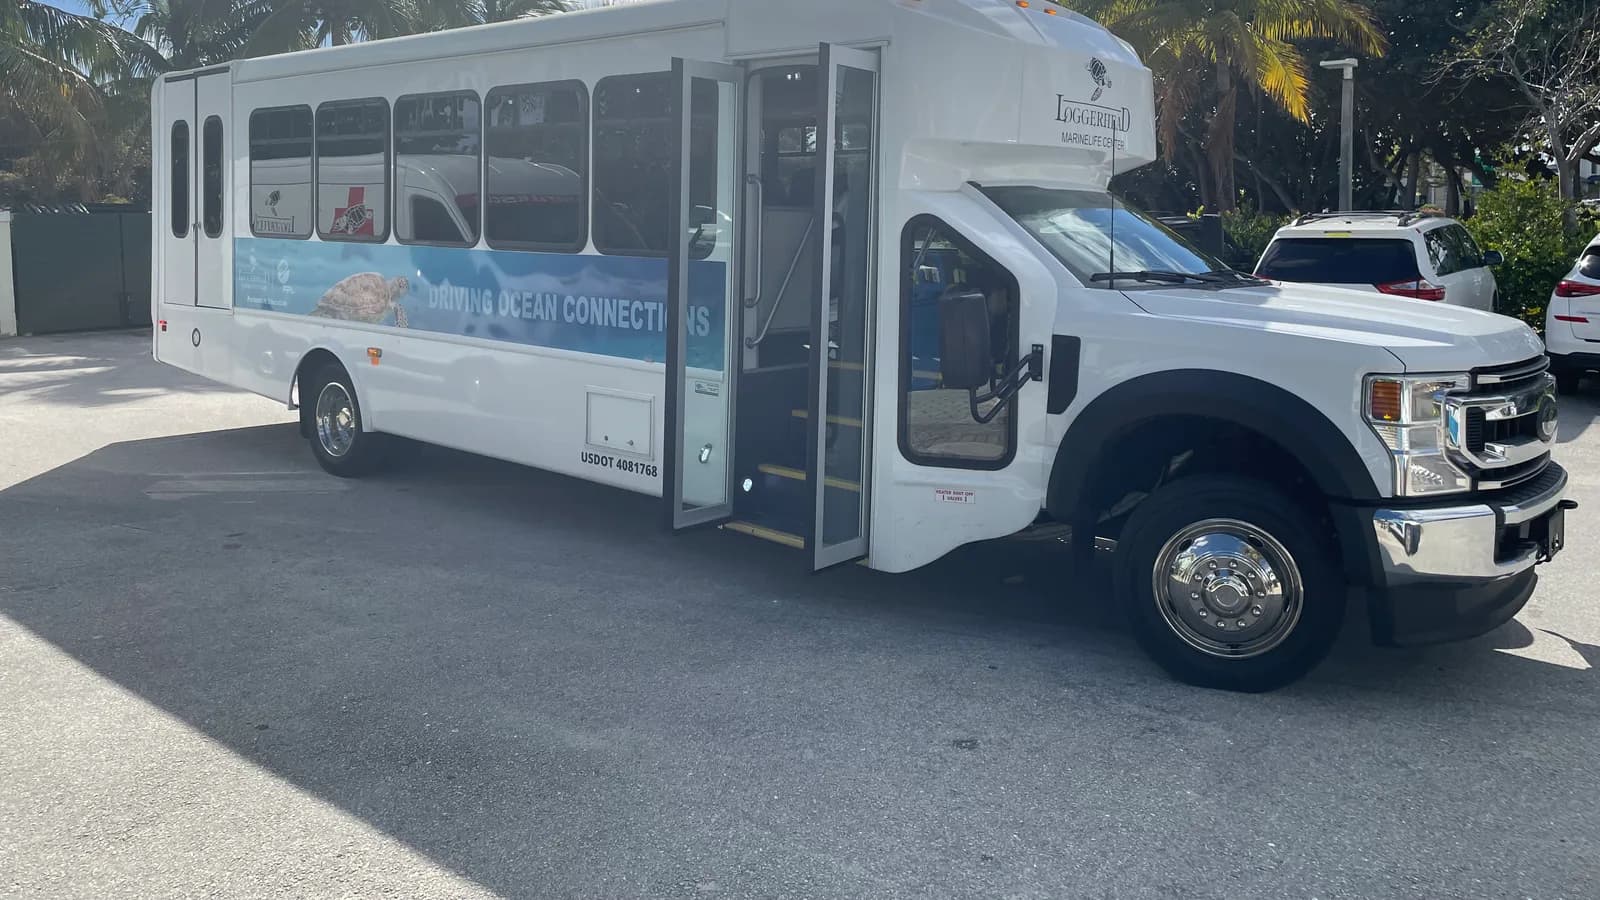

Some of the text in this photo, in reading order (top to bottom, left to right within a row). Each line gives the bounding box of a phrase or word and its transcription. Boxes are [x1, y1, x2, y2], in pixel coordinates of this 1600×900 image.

[428, 285, 710, 337] DRIVING OCEAN CONNECTINS
[581, 451, 658, 477] USDOT 4081768
